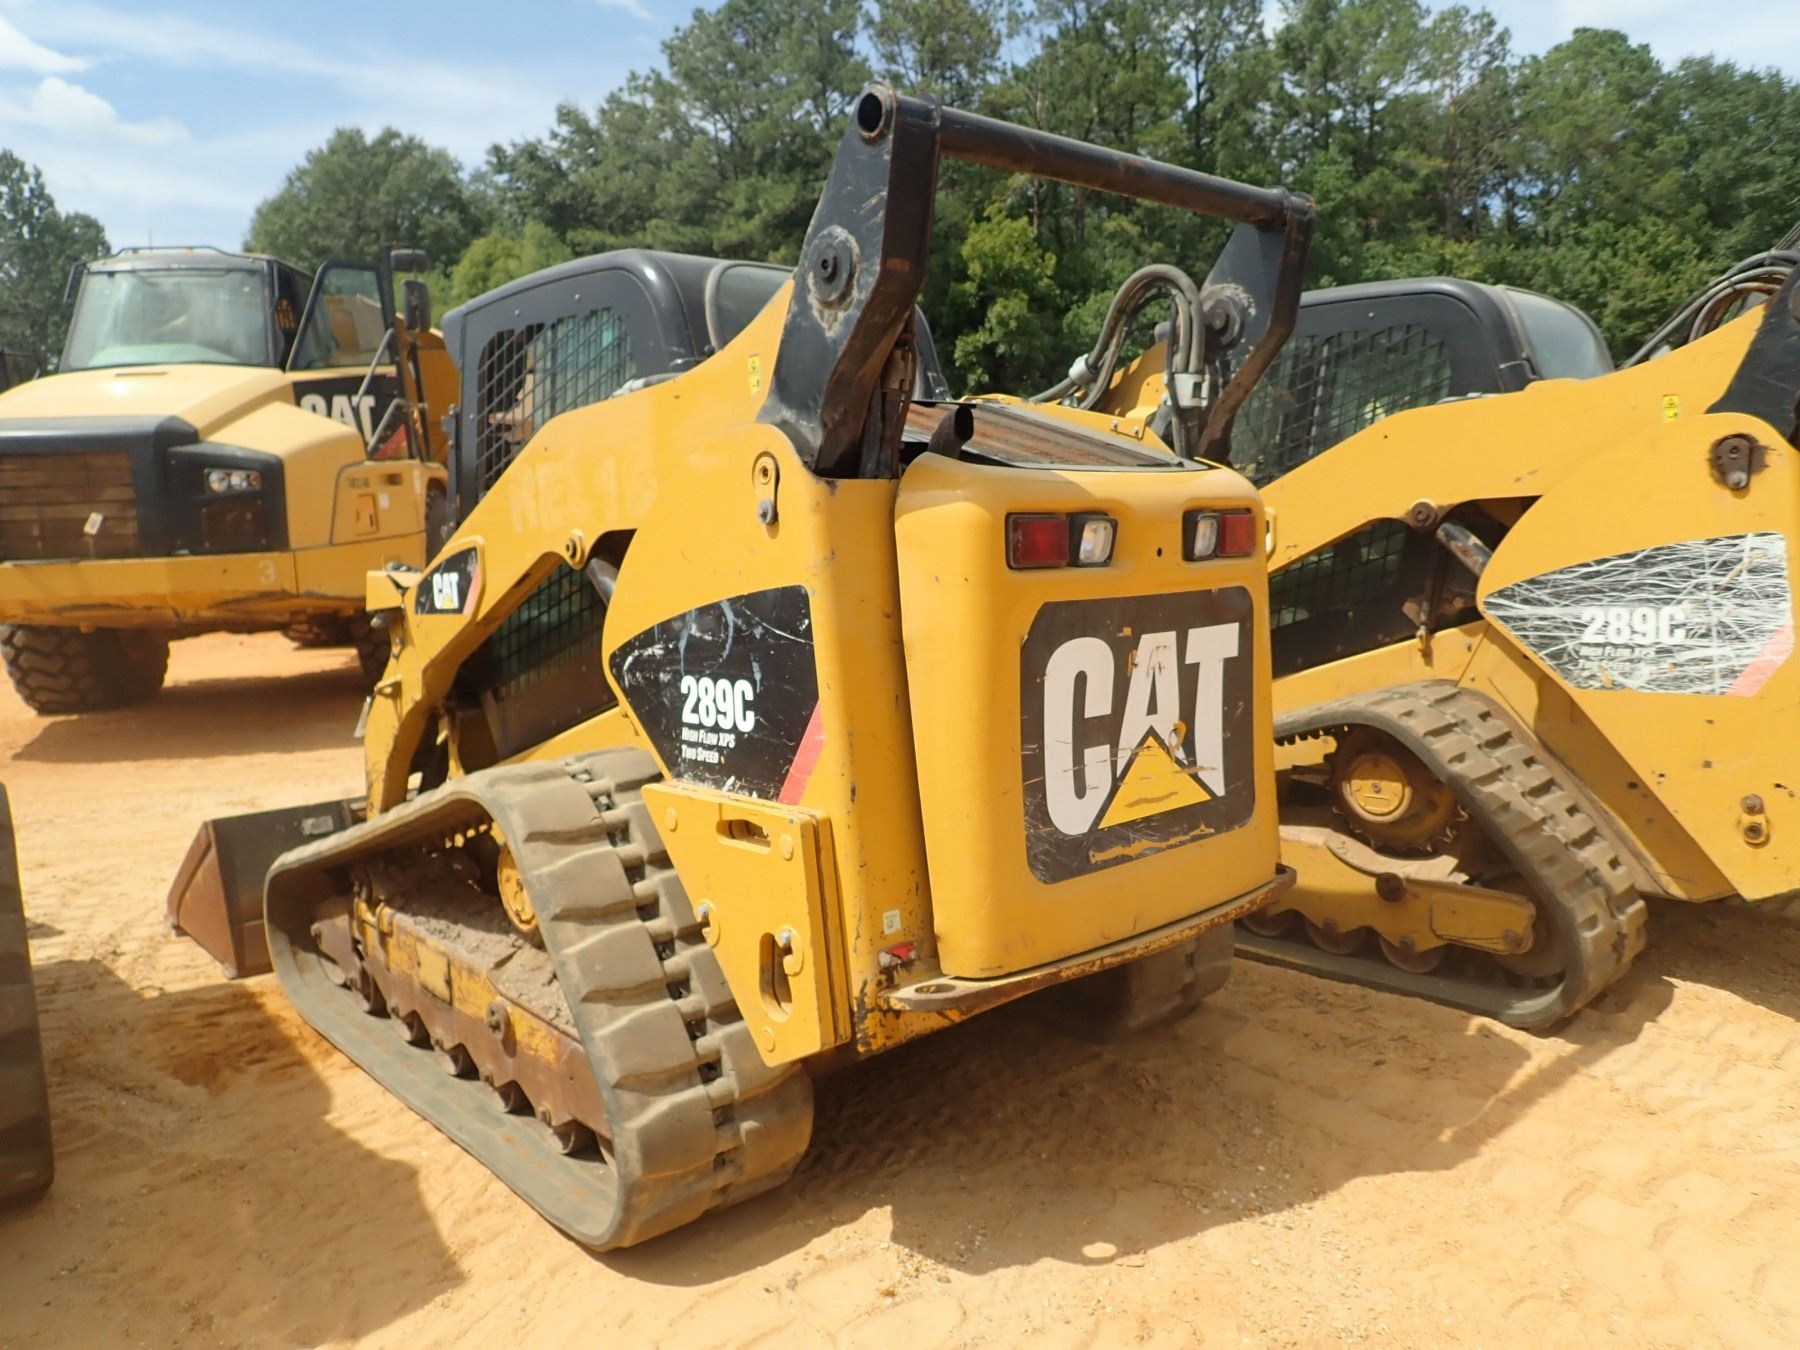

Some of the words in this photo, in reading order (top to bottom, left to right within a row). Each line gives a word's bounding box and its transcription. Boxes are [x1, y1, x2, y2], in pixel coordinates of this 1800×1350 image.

[432, 571, 459, 610] CAT
[1581, 606, 1687, 645] 289C
[680, 675, 756, 733] 289C
[1044, 622, 1240, 836] CAT
